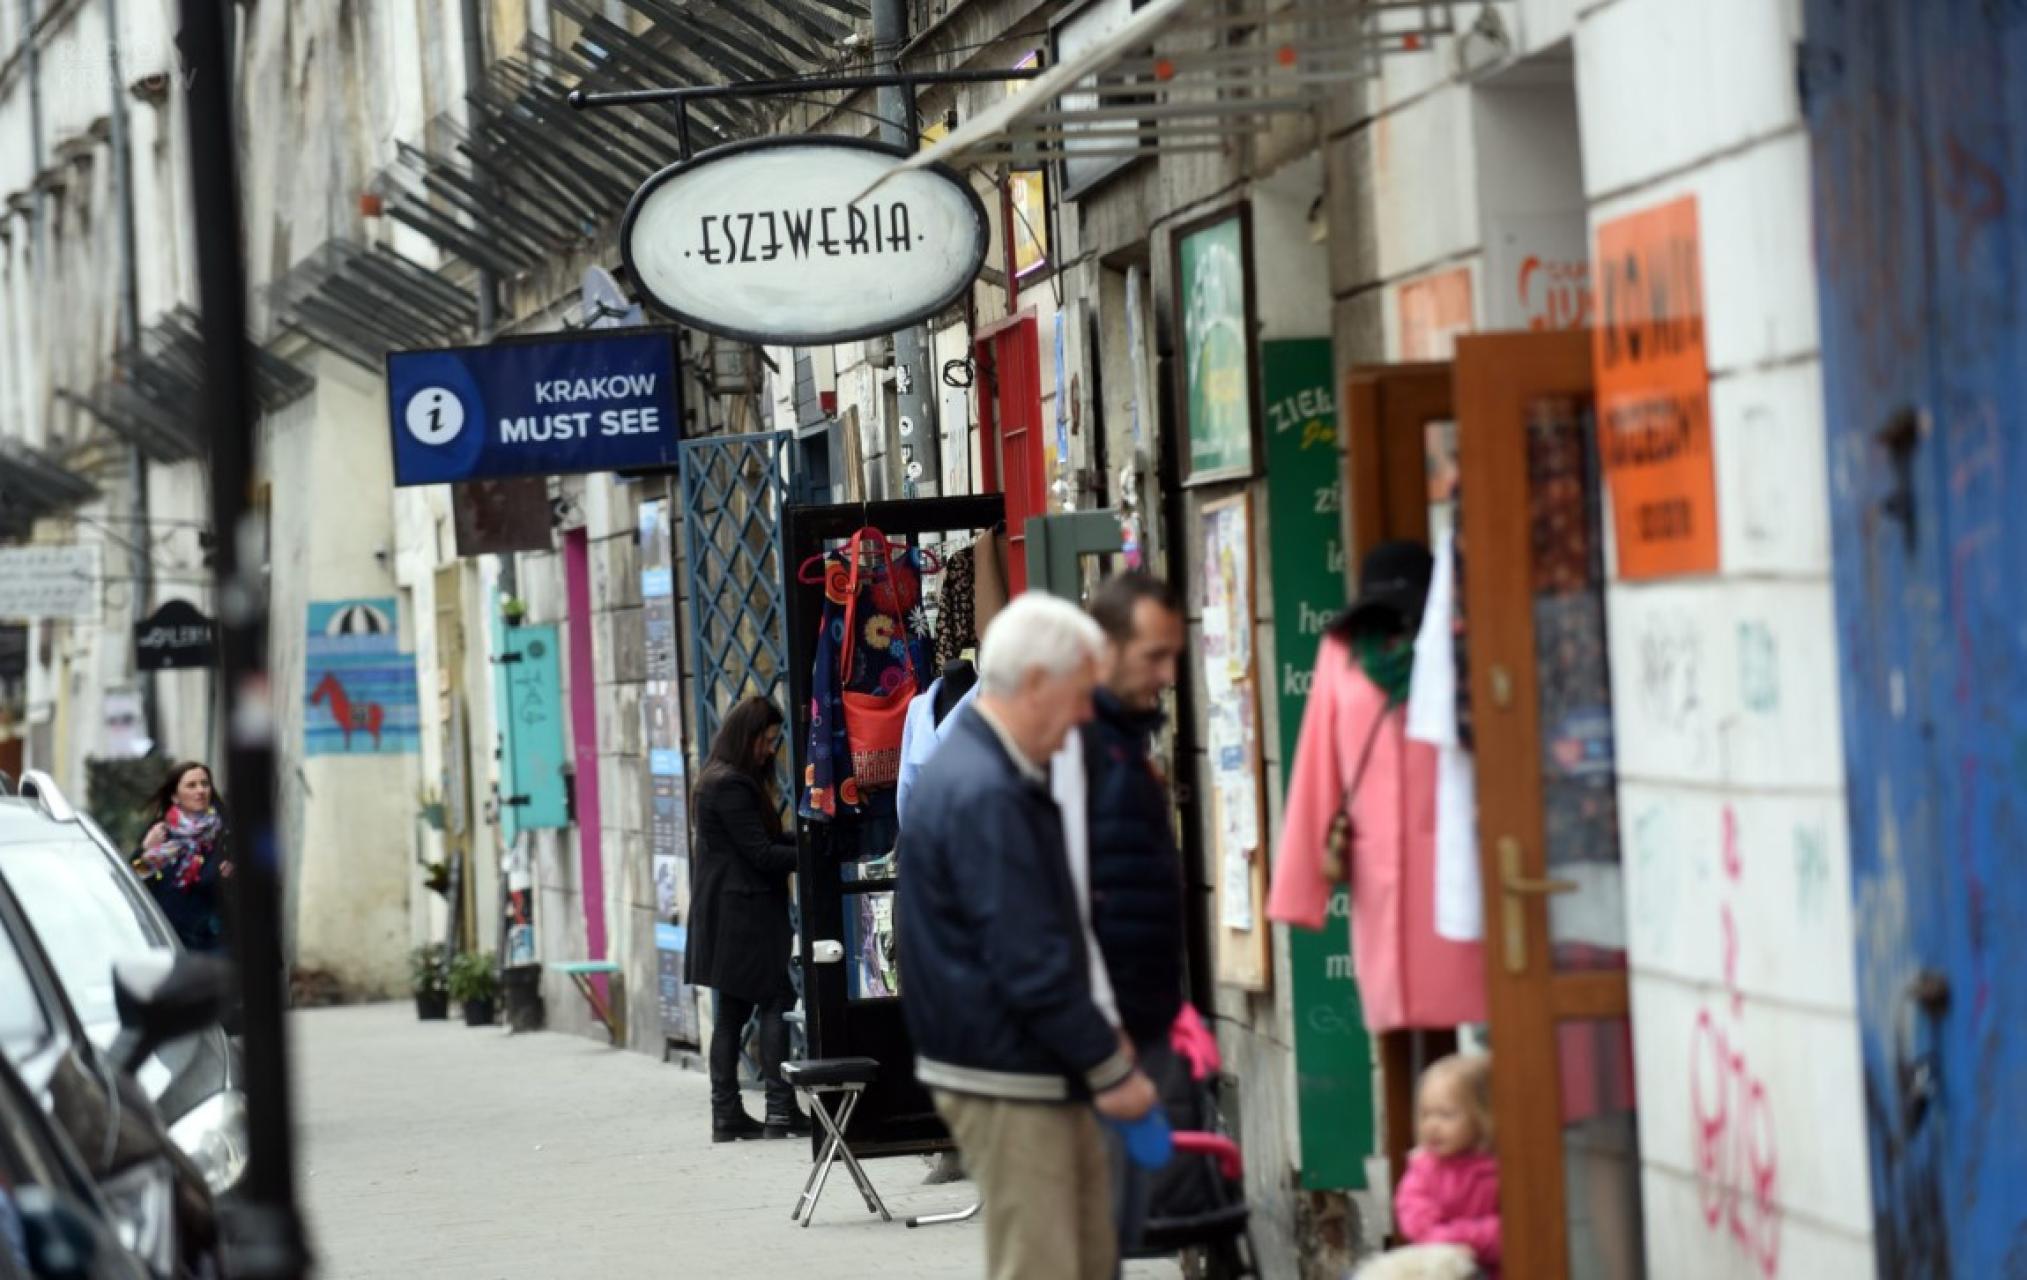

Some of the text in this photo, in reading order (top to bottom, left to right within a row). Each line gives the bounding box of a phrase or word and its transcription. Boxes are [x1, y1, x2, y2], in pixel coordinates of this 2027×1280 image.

[535, 373, 656, 404] KRAKOW
[500, 407, 659, 443] MUST SEE
